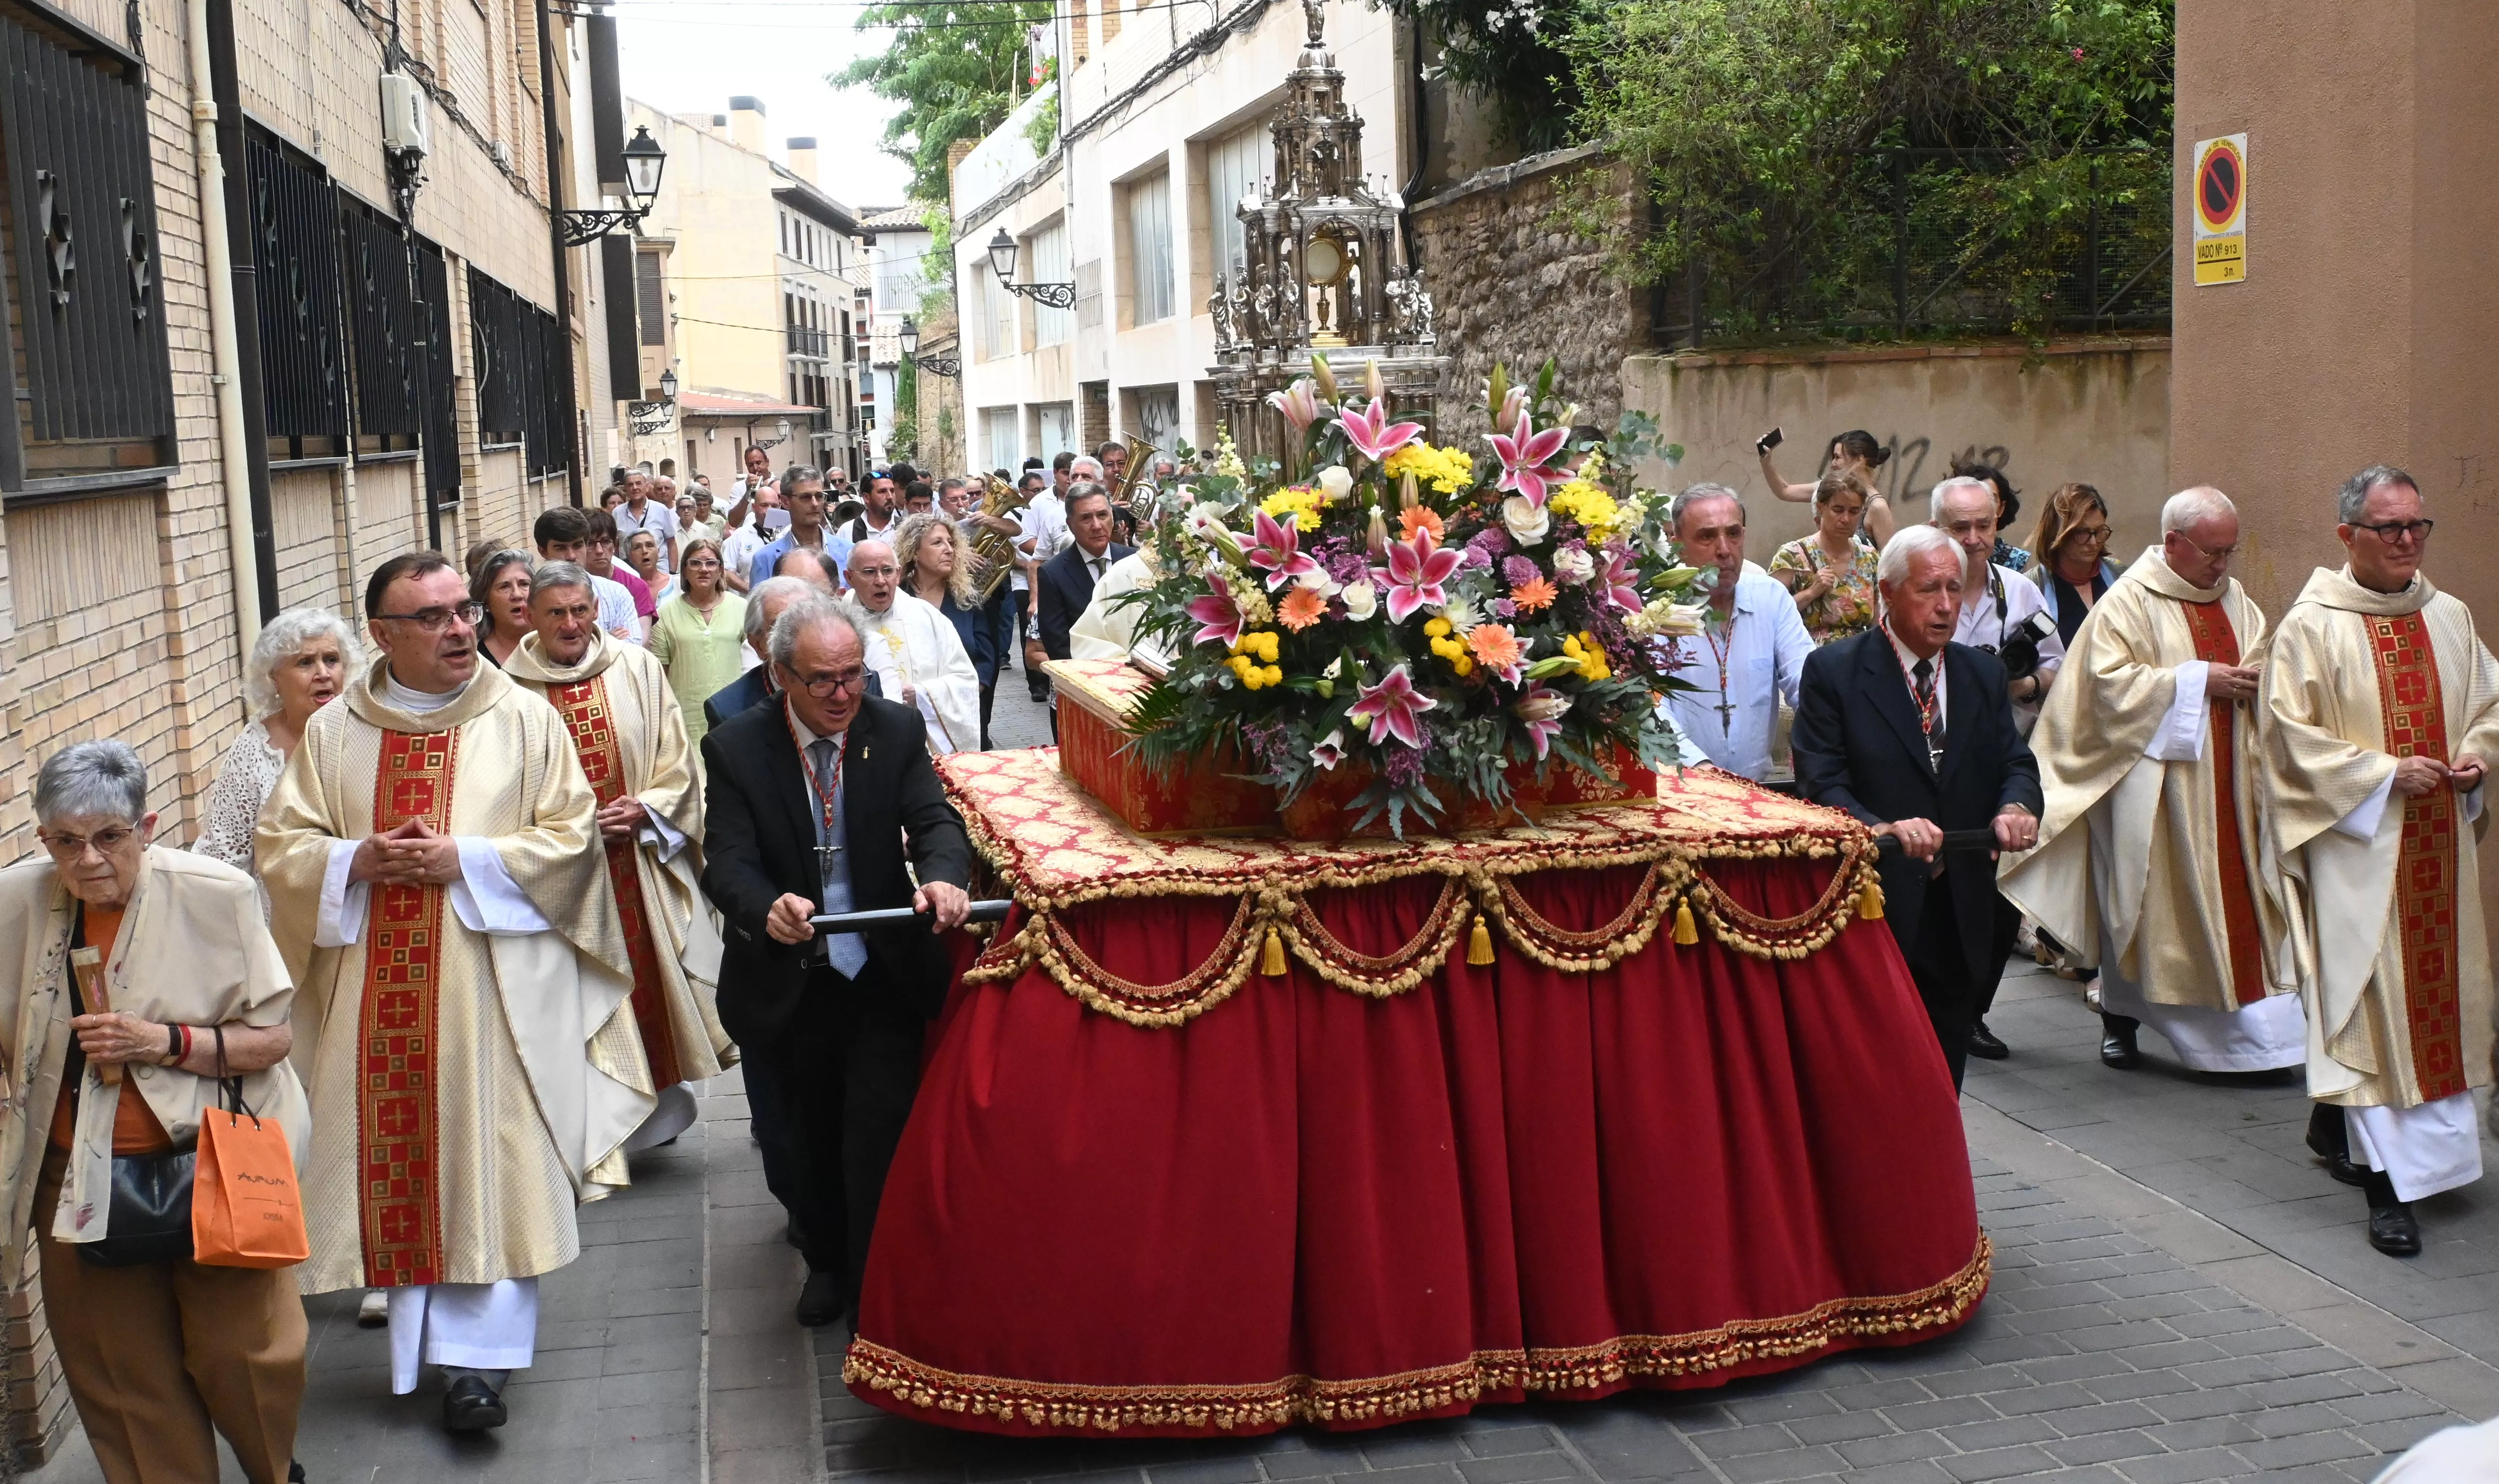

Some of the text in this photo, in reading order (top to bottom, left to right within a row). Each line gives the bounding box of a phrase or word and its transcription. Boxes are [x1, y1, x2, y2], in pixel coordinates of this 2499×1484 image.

[2200, 147, 2211, 169] SALIDA
[2198, 244, 2214, 259] VADO
[2225, 244, 2237, 255] 913
